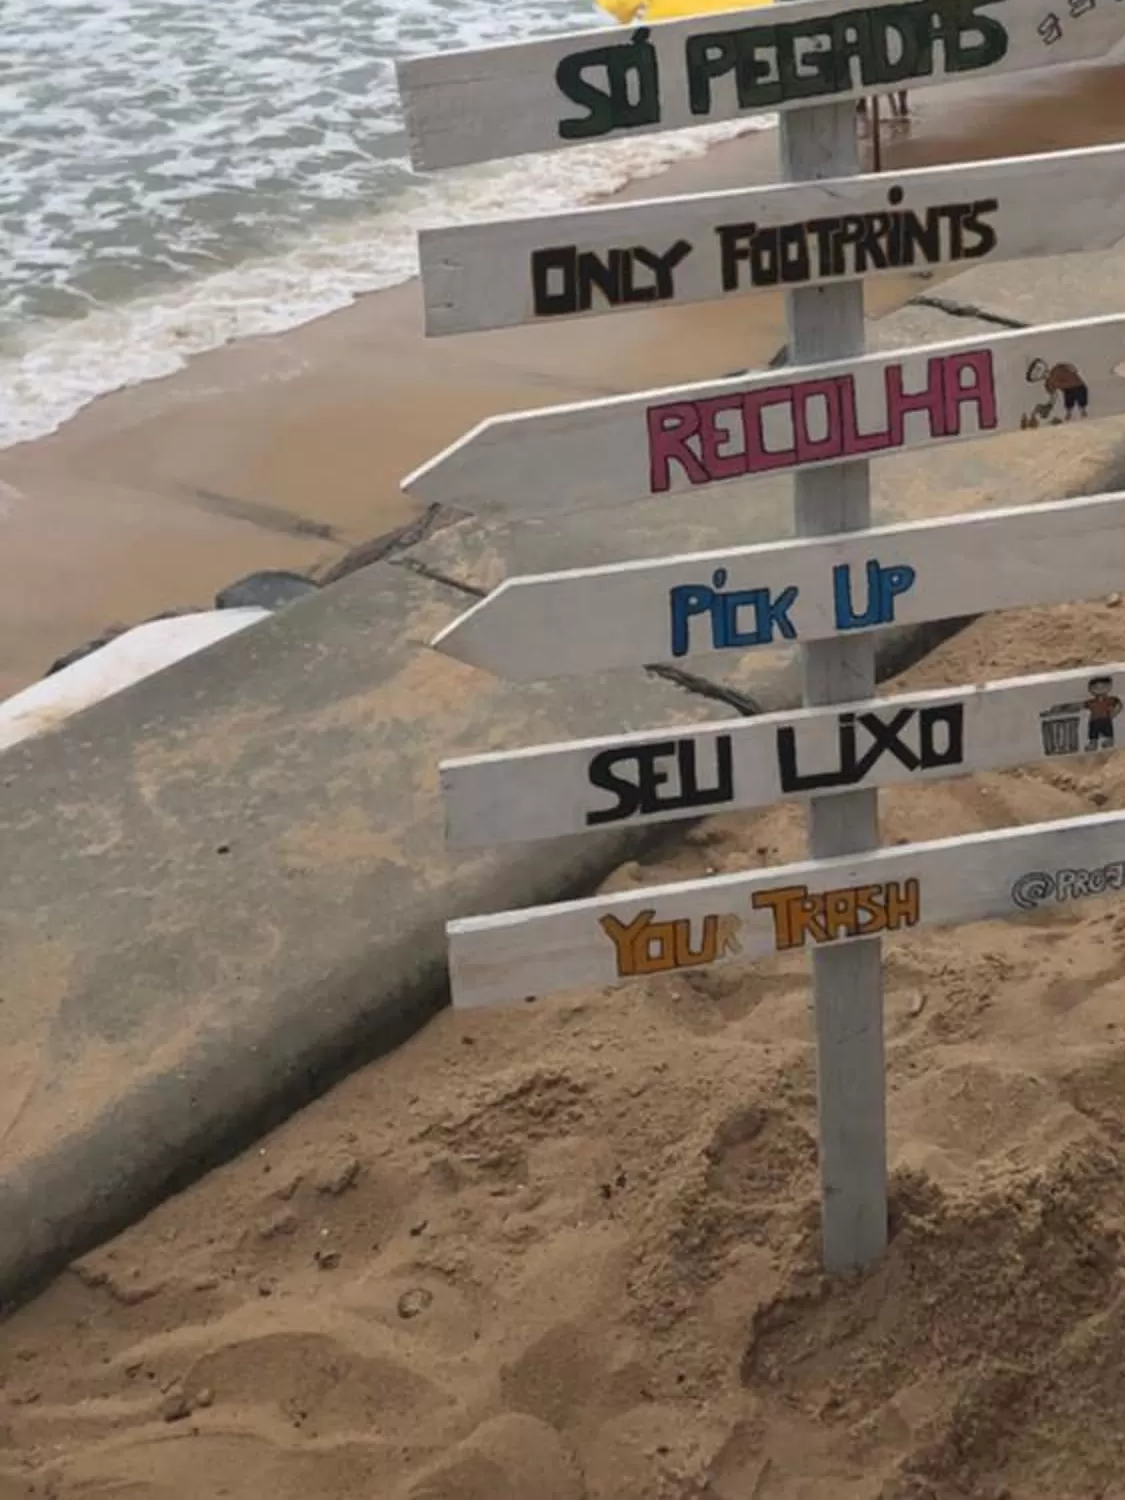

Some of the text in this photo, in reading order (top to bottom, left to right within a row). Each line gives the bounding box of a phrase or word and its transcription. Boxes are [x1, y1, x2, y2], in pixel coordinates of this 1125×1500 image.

[555, 26, 662, 140] SÓ
[531, 238, 693, 316] ONLY
[646, 349, 999, 493] RECOLHA
[833, 559, 917, 632] UP
[585, 734, 734, 826] SEU
[600, 878, 921, 978] YOUR TRASH
